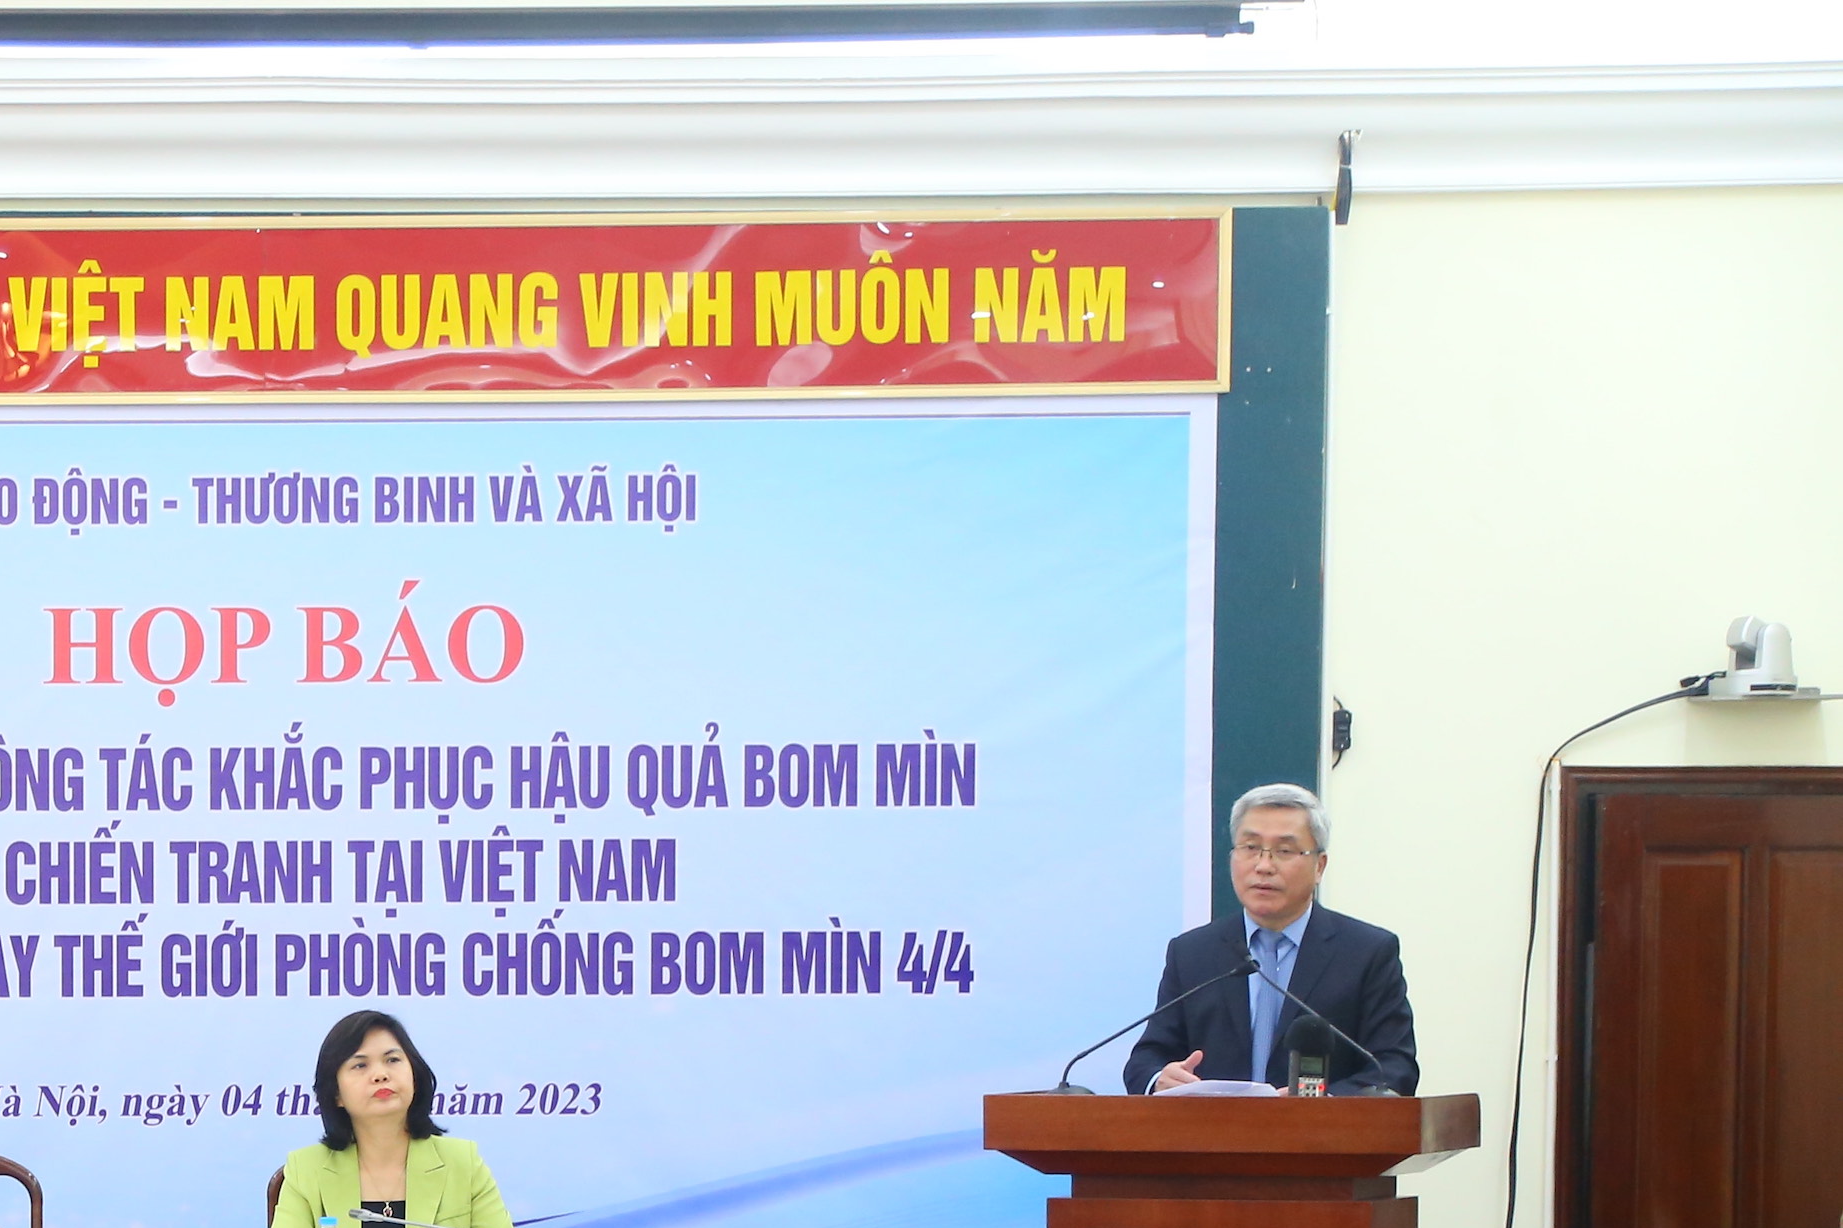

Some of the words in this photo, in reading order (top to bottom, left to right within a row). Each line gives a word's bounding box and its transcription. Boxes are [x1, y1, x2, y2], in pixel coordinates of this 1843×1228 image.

[9, 260, 145, 368] VIỆT
[166, 275, 315, 351] NAM
[336, 272, 559, 359] QUANG
[579, 270, 732, 348] VINH
[756, 251, 950, 347] MUÔN
[973, 249, 1126, 343] NĂM
[32, 467, 148, 536] ĐỘNG
[162, 499, 178, 510] -
[192, 471, 359, 524] THƯƠNG
[374, 476, 475, 523] BINH
[489, 465, 543, 522] VÀ
[556, 465, 613, 522] XÃ
[627, 463, 697, 532] HỘI
[43, 606, 271, 706] HỌP
[296, 580, 525, 683] BÁO
[99, 733, 193, 812] TÁC
[209, 721, 343, 811] KHẮC
[359, 745, 494, 825] PHỤC
[510, 731, 611, 824] HẬU
[627, 721, 729, 817] QUẢ
[744, 743, 859, 808] BOM
[875, 728, 976, 807] MÌN
[5, 819, 155, 906] CHIẾN
[169, 840, 333, 904] TRANH
[347, 839, 423, 918] TẠI
[439, 825, 544, 918] VIỆT
[558, 838, 677, 903] NAM
[53, 912, 149, 998] THẾ
[160, 919, 258, 998] GIỚI
[275, 916, 446, 997] PHÒNG
[462, 908, 634, 997] CHỐNG
[650, 930, 765, 996] BOM
[781, 916, 882, 995] MÌN
[896, 929, 975, 995] 4/4
[33, 1084, 107, 1126] Nội,
[120, 1084, 211, 1126] ngày
[221, 1084, 263, 1117] 04
[515, 1082, 603, 1116] 2023
